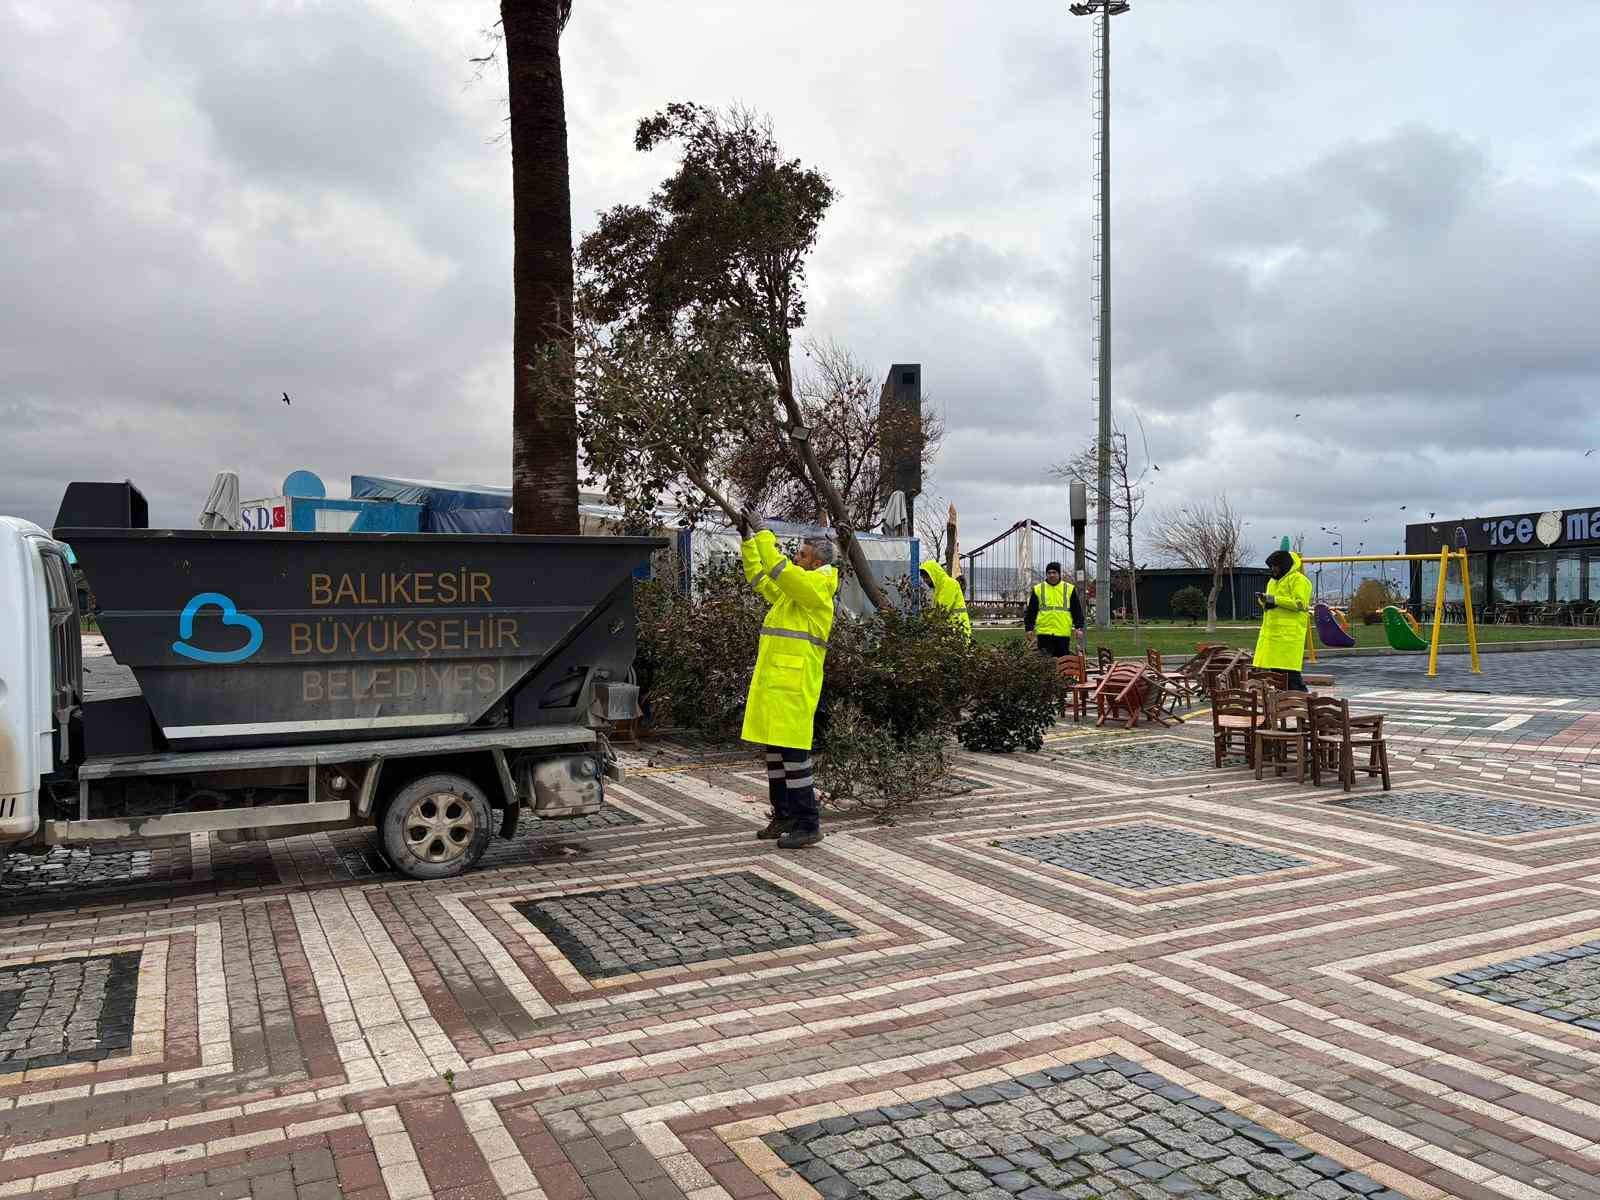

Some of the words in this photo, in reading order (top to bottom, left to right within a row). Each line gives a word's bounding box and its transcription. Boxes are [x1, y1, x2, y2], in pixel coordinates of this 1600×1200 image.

[310, 566, 493, 605] BALIKESİR
[290, 613, 520, 658] BÜYÜKŞEHİR
[302, 660, 505, 702] BELEDİYESİ
